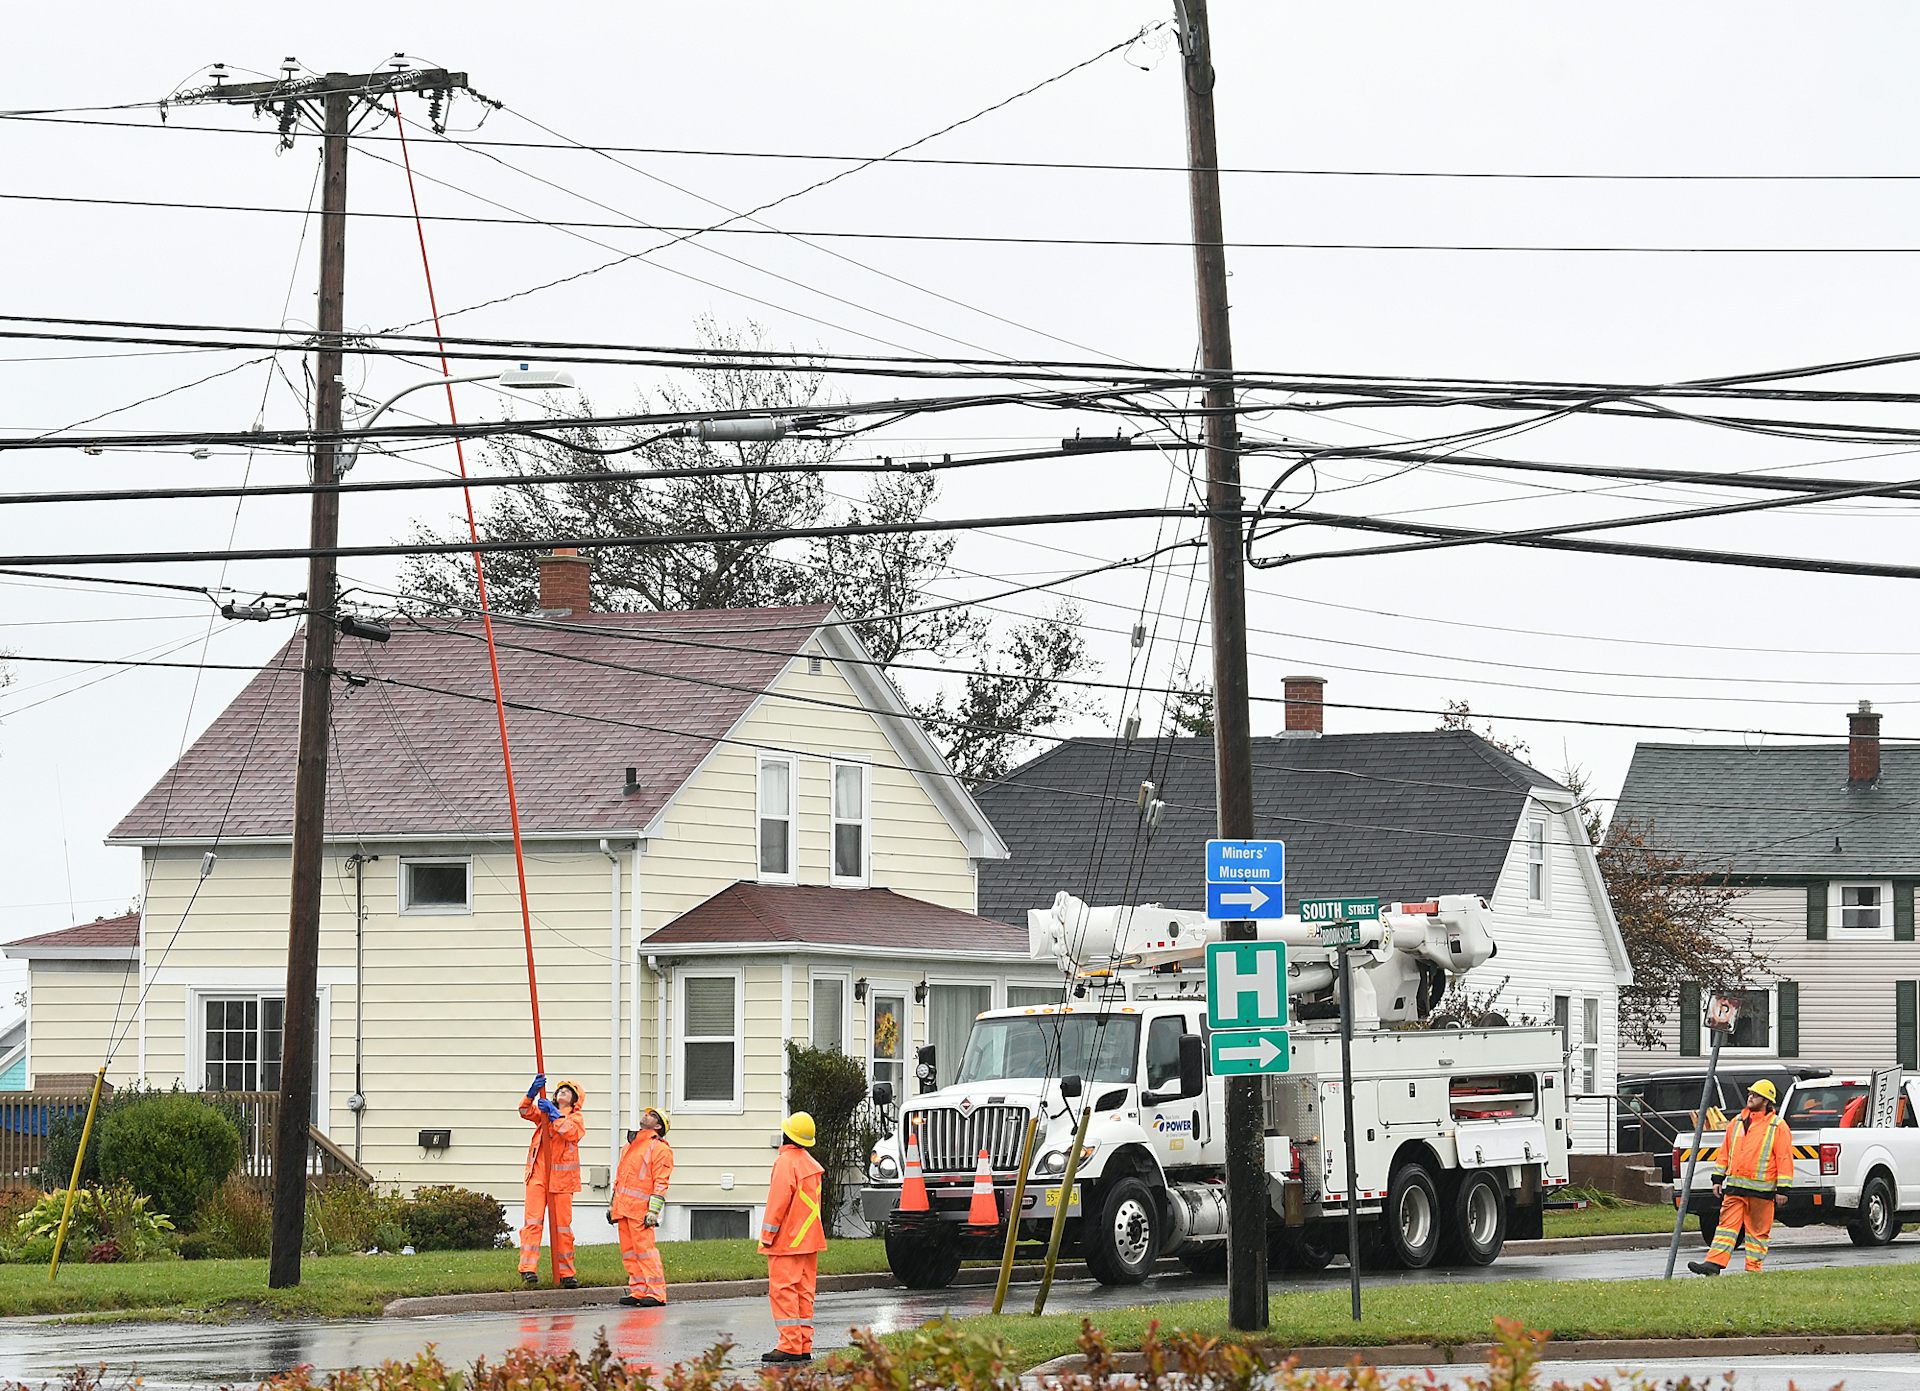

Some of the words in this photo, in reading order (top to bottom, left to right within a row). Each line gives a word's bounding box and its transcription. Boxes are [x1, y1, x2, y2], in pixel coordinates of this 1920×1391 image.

[1222, 846, 1267, 859] Miners'
[1219, 865, 1270, 878] Museum
[1302, 902, 1342, 920] SOUTH
[1348, 904, 1375, 915] STREET
[1322, 925, 1353, 945] BROOKSIDE
[1215, 950, 1279, 1020] H
[1877, 1075, 1888, 1128] TRAFFIC
[1885, 1097, 1894, 1128] LOC
[1166, 1120, 1192, 1132] POWER
